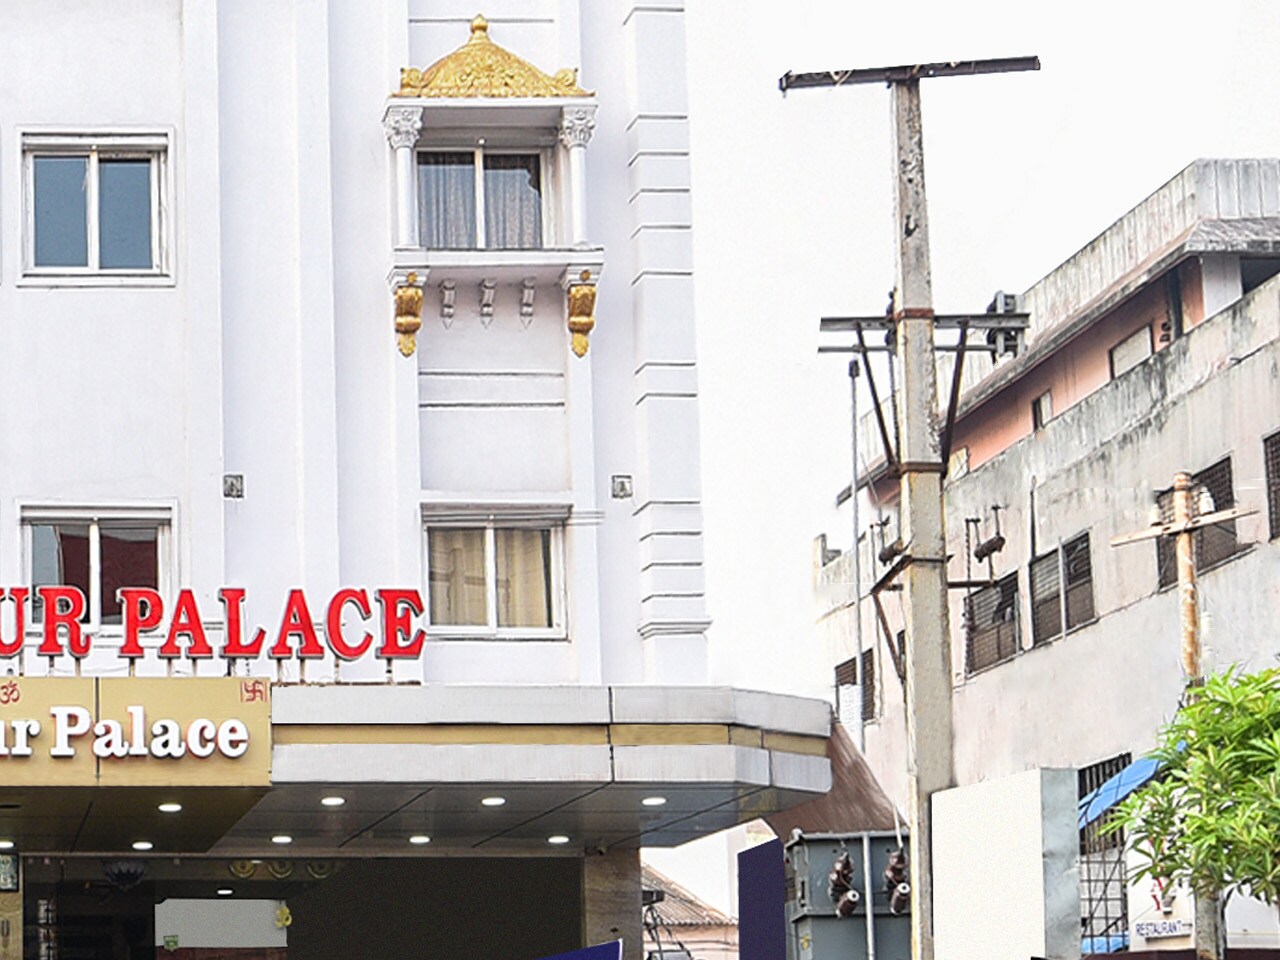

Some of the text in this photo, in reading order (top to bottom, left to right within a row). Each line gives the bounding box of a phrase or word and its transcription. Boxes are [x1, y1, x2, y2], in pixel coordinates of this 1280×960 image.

[117, 587, 426, 662] PALACE
[49, 706, 250, 759] Palace
[1135, 920, 1182, 937] RESTAURANT
